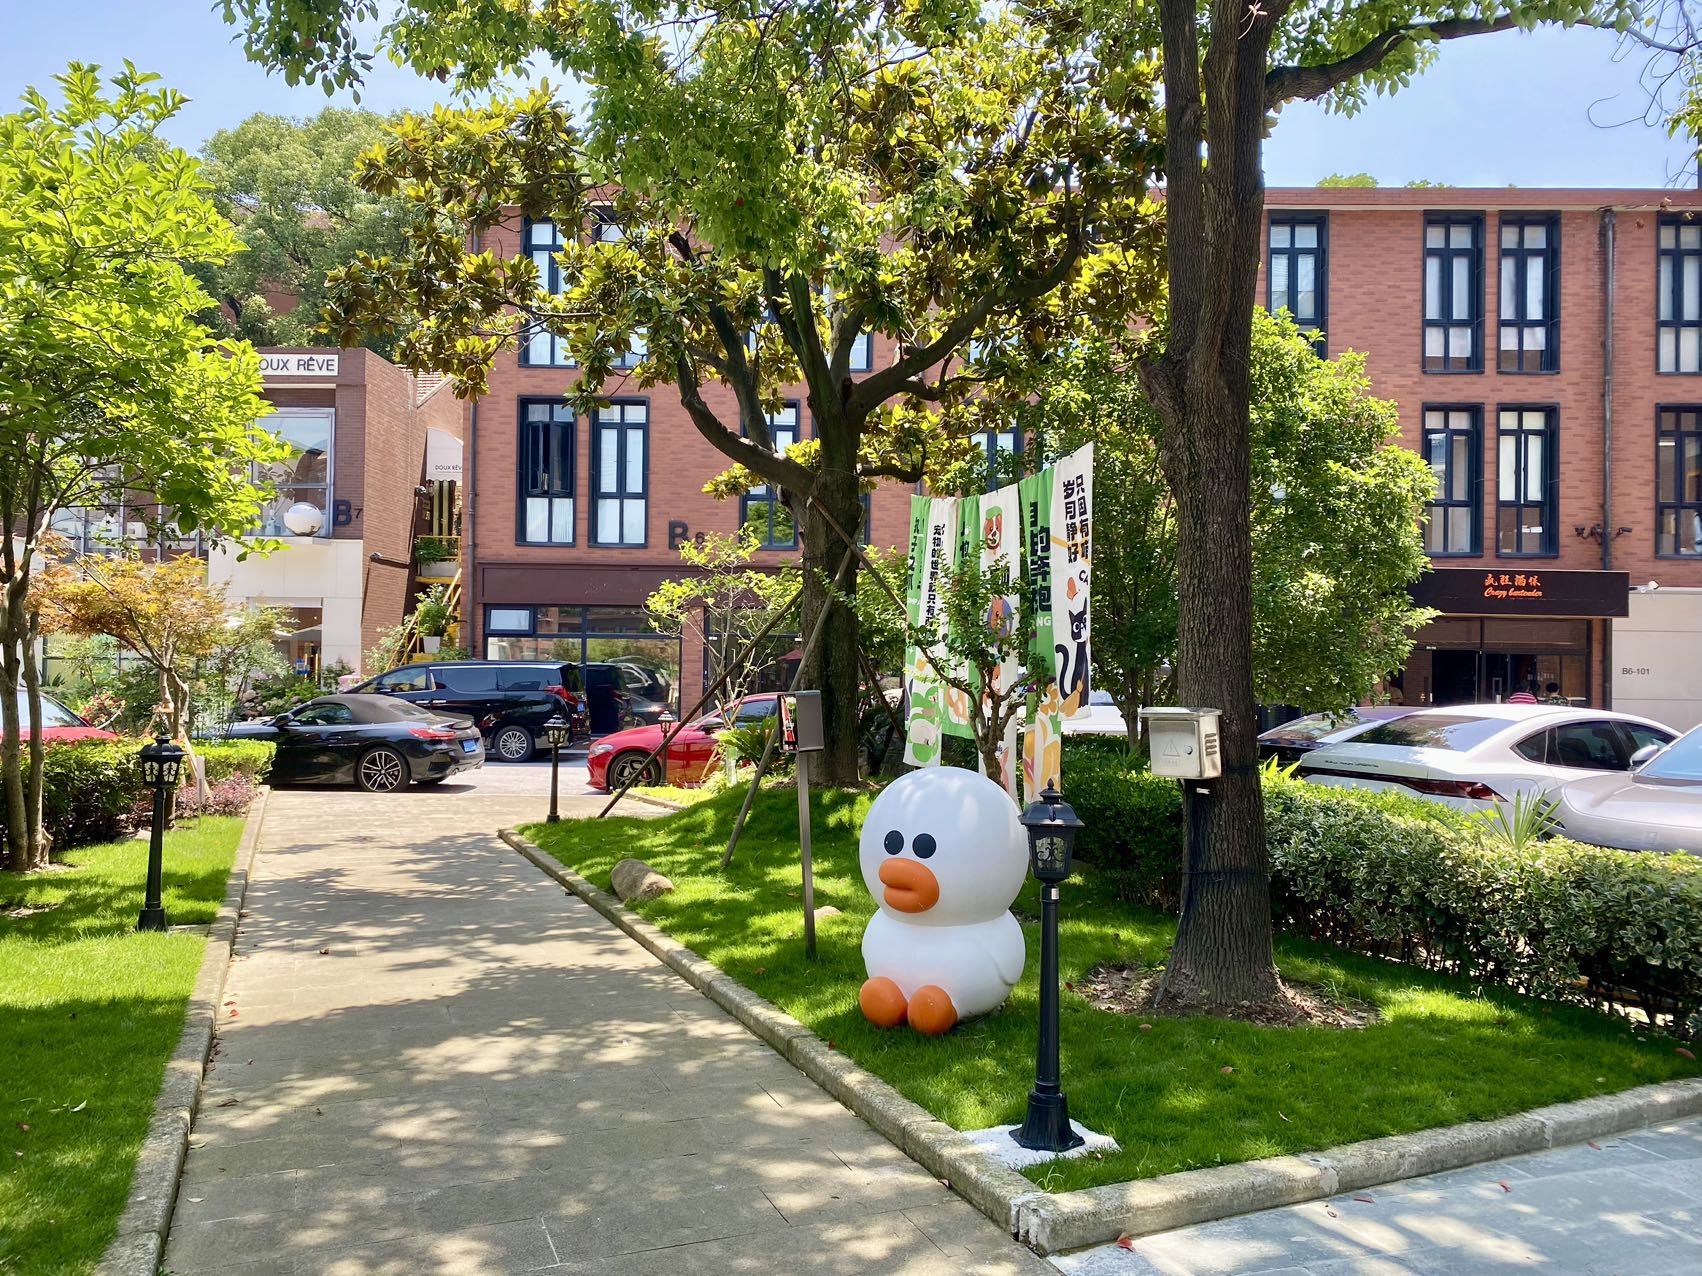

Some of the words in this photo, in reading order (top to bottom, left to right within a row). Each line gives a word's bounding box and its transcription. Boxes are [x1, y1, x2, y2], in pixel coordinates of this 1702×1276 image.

[258, 358, 290, 371] OUX
[297, 355, 335, 371] RÊVE
[1062, 479, 1079, 563] 岁月静好
[1622, 667, 1650, 675] B6-101
